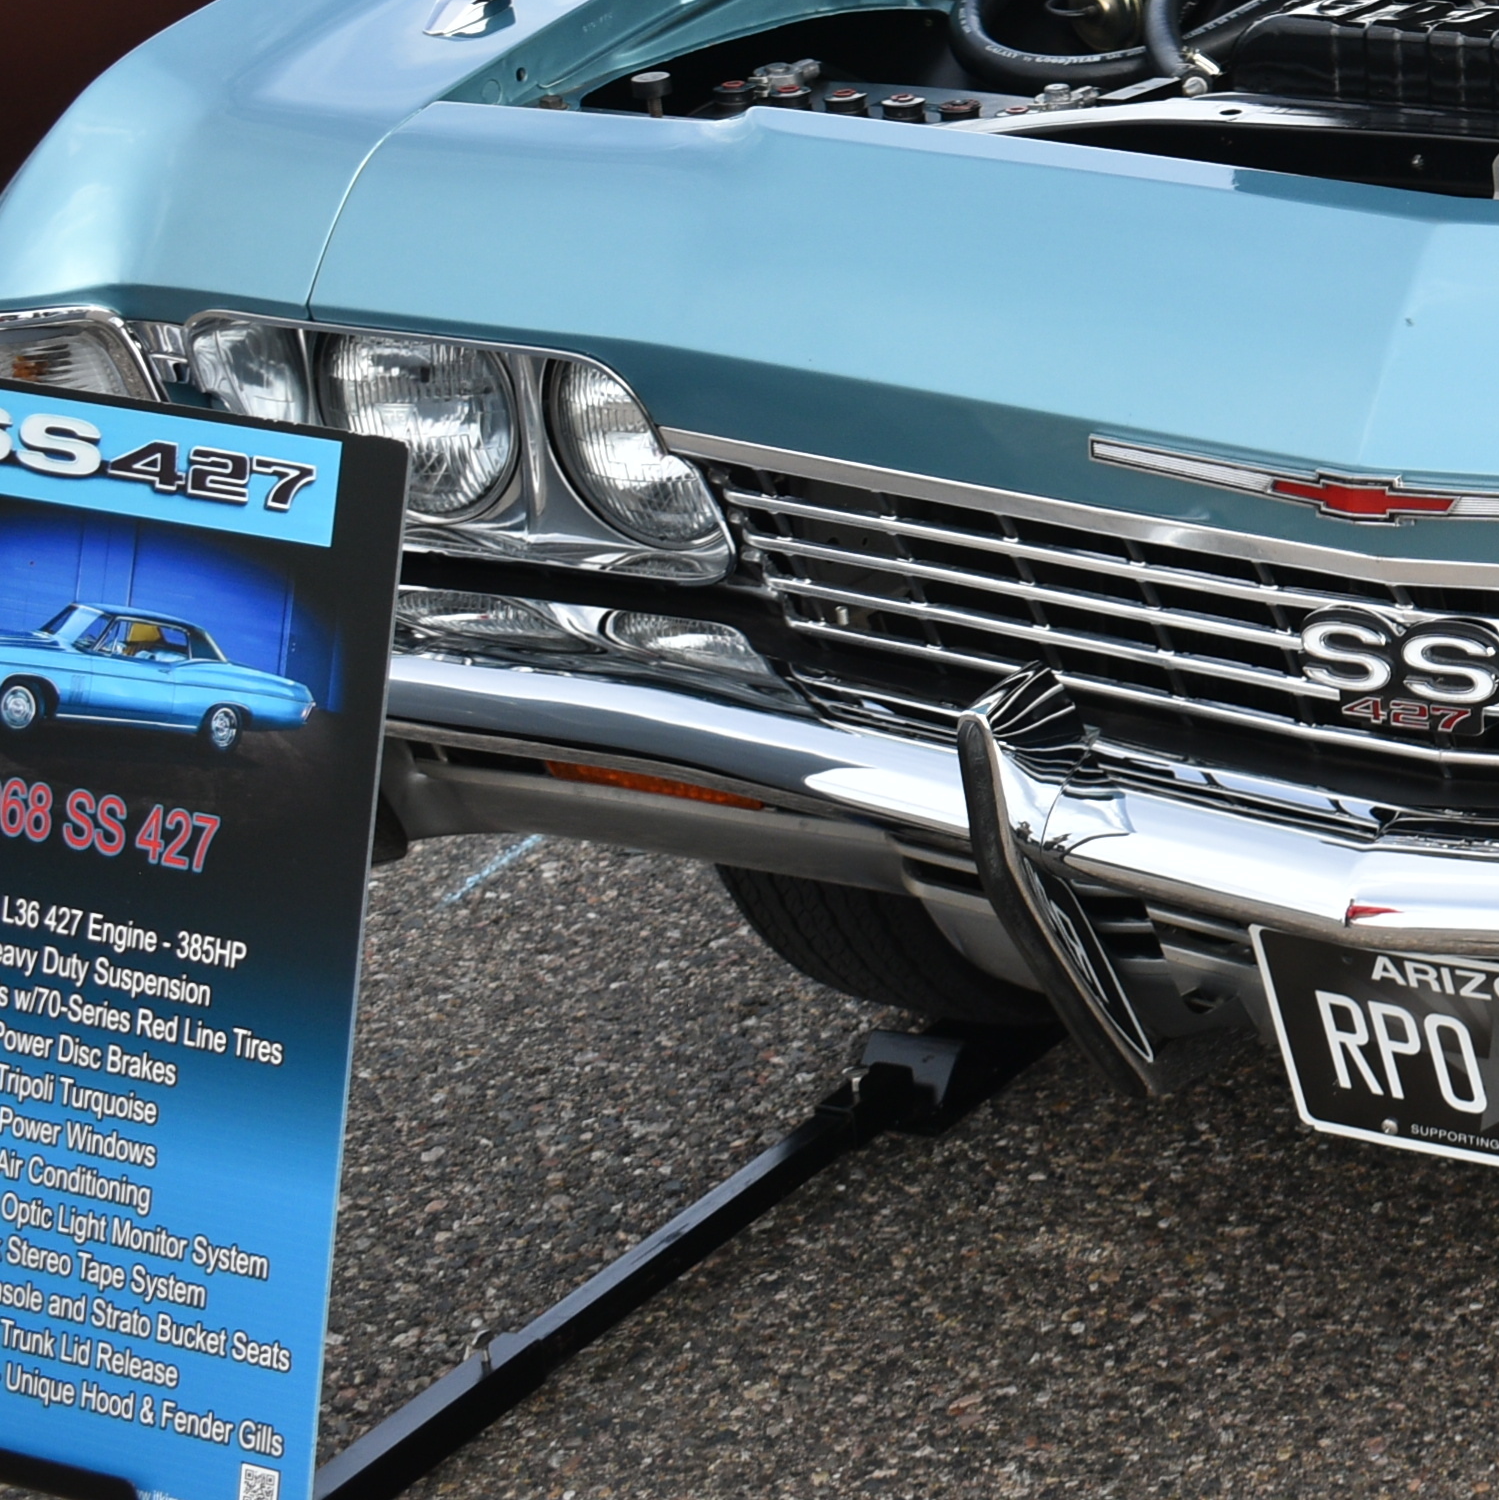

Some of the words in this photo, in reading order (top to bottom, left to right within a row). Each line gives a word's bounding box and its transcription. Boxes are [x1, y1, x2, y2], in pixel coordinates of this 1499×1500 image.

[0, 406, 102, 479] S
[106, 439, 318, 512] 427
[1302, 621, 1499, 703] SS
[1341, 696, 1472, 733] 427
[0, 777, 52, 842] 68
[62, 788, 127, 856] SS
[135, 804, 220, 872] 427
[2, 895, 40, 929] L36
[44, 904, 84, 937] 427
[87, 912, 158, 954] Engine
[175, 930, 248, 970] 385HP
[0, 943, 39, 977] avy
[42, 946, 90, 986] Duty
[93, 956, 211, 1007] Suspension
[14, 986, 131, 1034] w/70-Series
[136, 1007, 178, 1044] Red
[183, 1017, 227, 1053] Line
[232, 1027, 284, 1066] Tires
[57, 1035, 103, 1071] Disc
[106, 1045, 178, 1086] Brakes
[0, 1063, 56, 1103] Tripoli
[60, 1076, 158, 1124] Turquoise
[0, 1106, 61, 1145] Power
[65, 1121, 157, 1168] Windows
[0, 1148, 24, 1180] Air
[27, 1156, 152, 1215] Conditioning
[1, 1192, 54, 1231] Optic
[57, 1204, 107, 1244] Light
[111, 1217, 188, 1260] Monitor
[191, 1236, 269, 1280] System
[6, 1235, 72, 1277] Stereo
[76, 1251, 127, 1292] Tape
[130, 1265, 207, 1308] System
[0, 1282, 43, 1312] sole
[47, 1293, 87, 1324] and
[91, 1298, 152, 1339] Strato
[155, 1313, 227, 1358] Bucket
[231, 1331, 292, 1372] Seats
[0, 1318, 56, 1359] Trunk
[60, 1332, 92, 1368] Lid
[95, 1343, 180, 1387] Release
[5, 1361, 77, 1407] Unique
[80, 1381, 136, 1421] Hood
[139, 1396, 157, 1426] &
[160, 1400, 235, 1445] Fender
[237, 1420, 285, 1458] Gills
